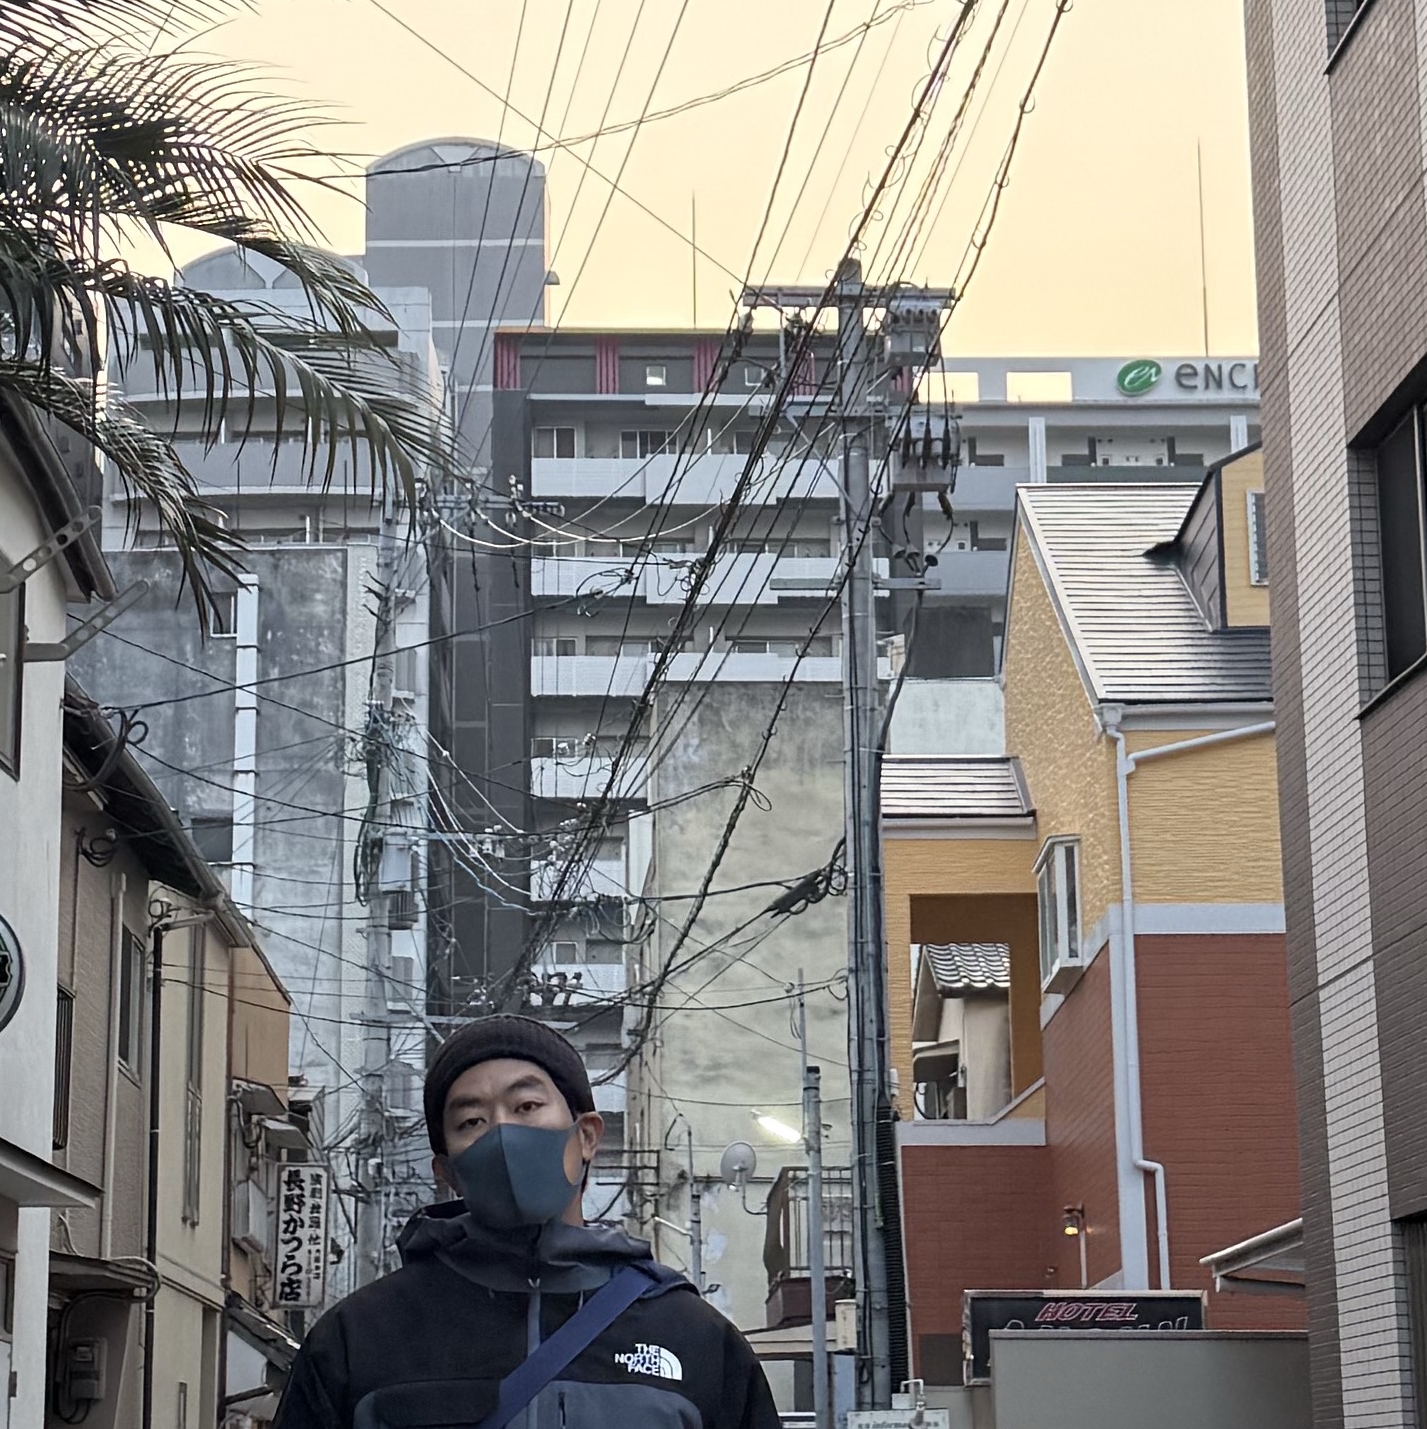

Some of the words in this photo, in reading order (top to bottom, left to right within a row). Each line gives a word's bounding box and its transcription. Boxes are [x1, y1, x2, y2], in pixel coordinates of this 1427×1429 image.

[279, 1169, 306, 1302] 長野かつら店
[1034, 1302, 1139, 1322] HOTEL
[635, 1343, 660, 1354] THE
[614, 1353, 660, 1365] NORTH
[627, 1364, 660, 1376] FACE
